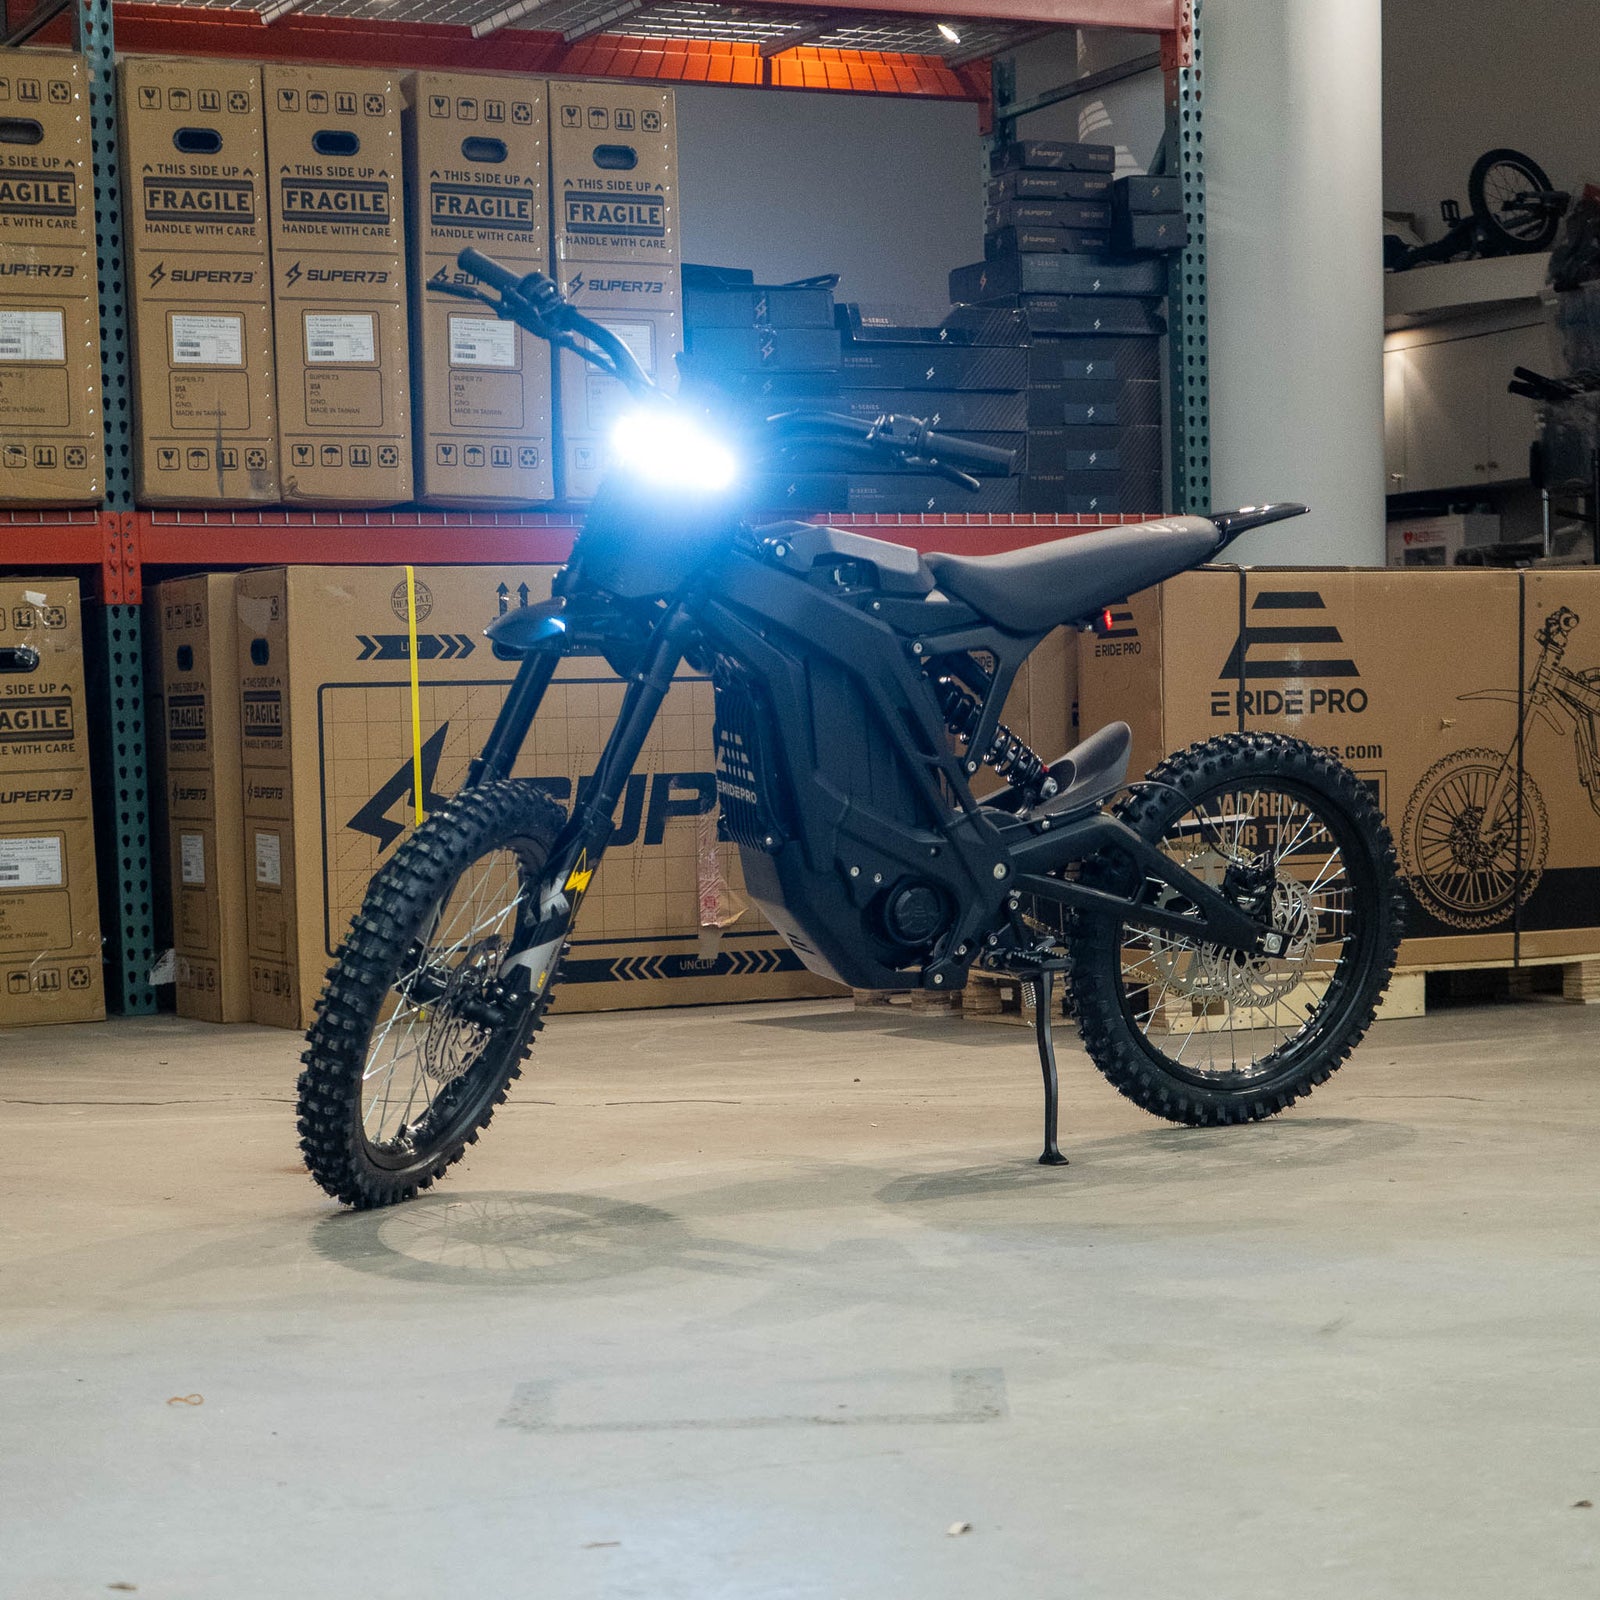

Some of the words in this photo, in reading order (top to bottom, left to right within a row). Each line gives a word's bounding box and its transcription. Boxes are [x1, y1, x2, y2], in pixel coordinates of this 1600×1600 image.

[9, 156, 38, 167] SIDE
[42, 157, 60, 168] UP
[157, 163, 186, 175] THIS
[190, 165, 219, 176] SIDE
[222, 166, 239, 176] UP
[295, 165, 323, 176] THIS
[327, 166, 355, 177] SIDE
[358, 168, 375, 178] UP
[444, 170, 471, 182] THIS
[474, 173, 501, 184] SIDE
[504, 175, 520, 185] UP
[577, 179, 603, 190] THIS
[607, 180, 633, 191] SIDE
[636, 182, 651, 192] UP
[0, 183, 71, 204] AGILE
[148, 190, 250, 211] FRAGILE
[286, 190, 385, 212] FRAGILE
[435, 195, 529, 219] FRAGILE
[569, 203, 661, 225] FRAGILE
[14, 218, 43, 228] WITH
[47, 219, 78, 229] CARE
[145, 223, 192, 234] HANDLE
[194, 225, 223, 235] WITH
[227, 226, 256, 236] CARE
[282, 224, 328, 234] HANDLE
[330, 226, 359, 236] WITH
[362, 227, 391, 237] CARE
[431, 227, 474, 239] HANDLE
[477, 231, 504, 241] WITH
[507, 233, 534, 243] CARE
[566, 236, 608, 246] HANDLE
[610, 237, 636, 247] WITH
[639, 239, 666, 248] CARE
[171, 270, 254, 284] SUPER73
[307, 269, 388, 283] SUPER73
[589, 279, 663, 293] SUPER73
[401, 641, 422, 652] LIT
[1102, 643, 1122, 656] RIDE
[1123, 641, 1142, 655] PRO
[6, 684, 35, 695] SIDE
[39, 683, 56, 694] UP
[1211, 691, 1231, 716] E
[1236, 689, 1303, 716] RIDE
[1310, 688, 1368, 714] PRO
[0, 709, 68, 731] AGILE
[171, 708, 204, 728] FRAGILE
[245, 703, 280, 724] FRAGILE
[12, 744, 42, 755] WITH
[45, 743, 75, 753] CARE
[679, 958, 716, 971] UNCLIP
